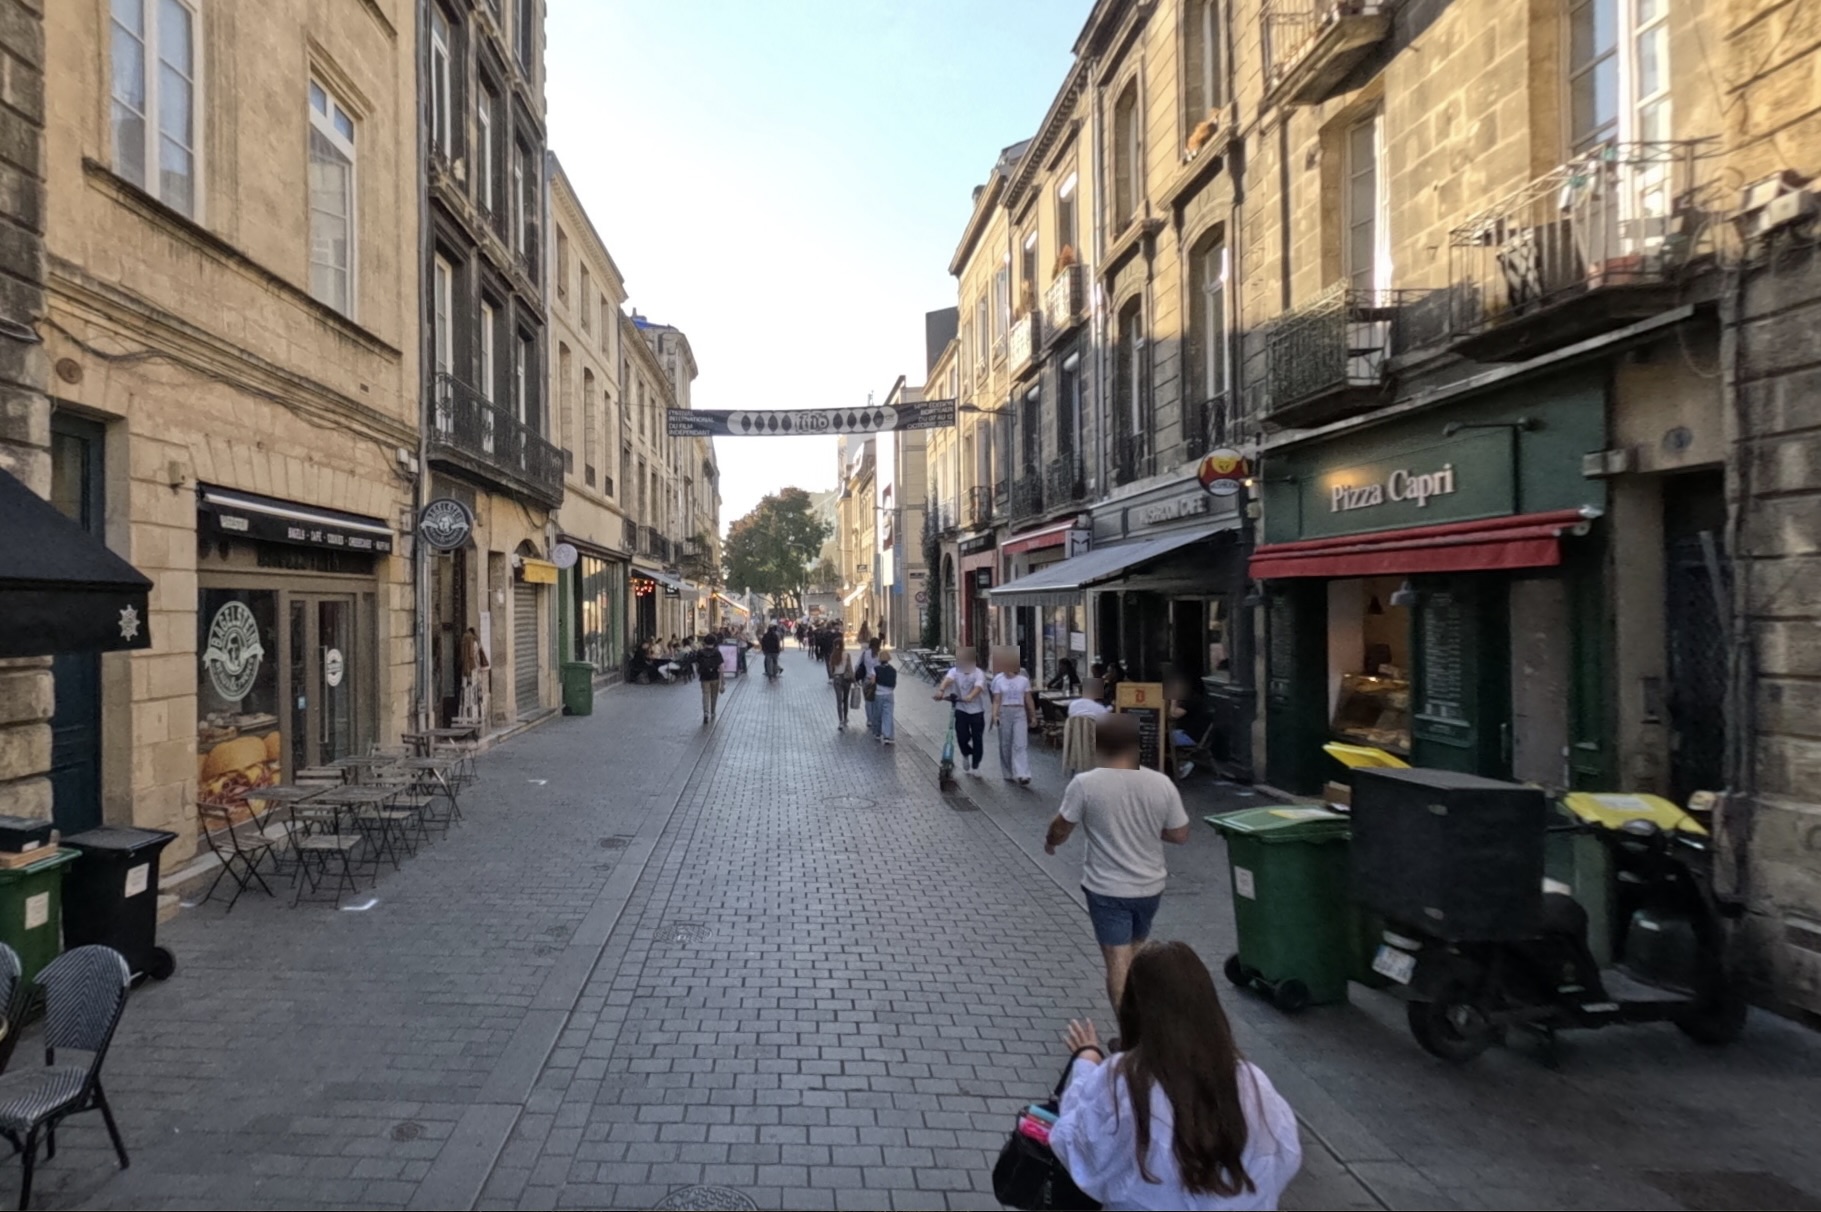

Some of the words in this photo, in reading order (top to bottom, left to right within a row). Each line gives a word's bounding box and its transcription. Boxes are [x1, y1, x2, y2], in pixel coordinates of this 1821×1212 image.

[1330, 483, 1384, 513] Pizza
[1388, 462, 1456, 508] Capri
[210, 606, 258, 648] BAGELSTEIN
